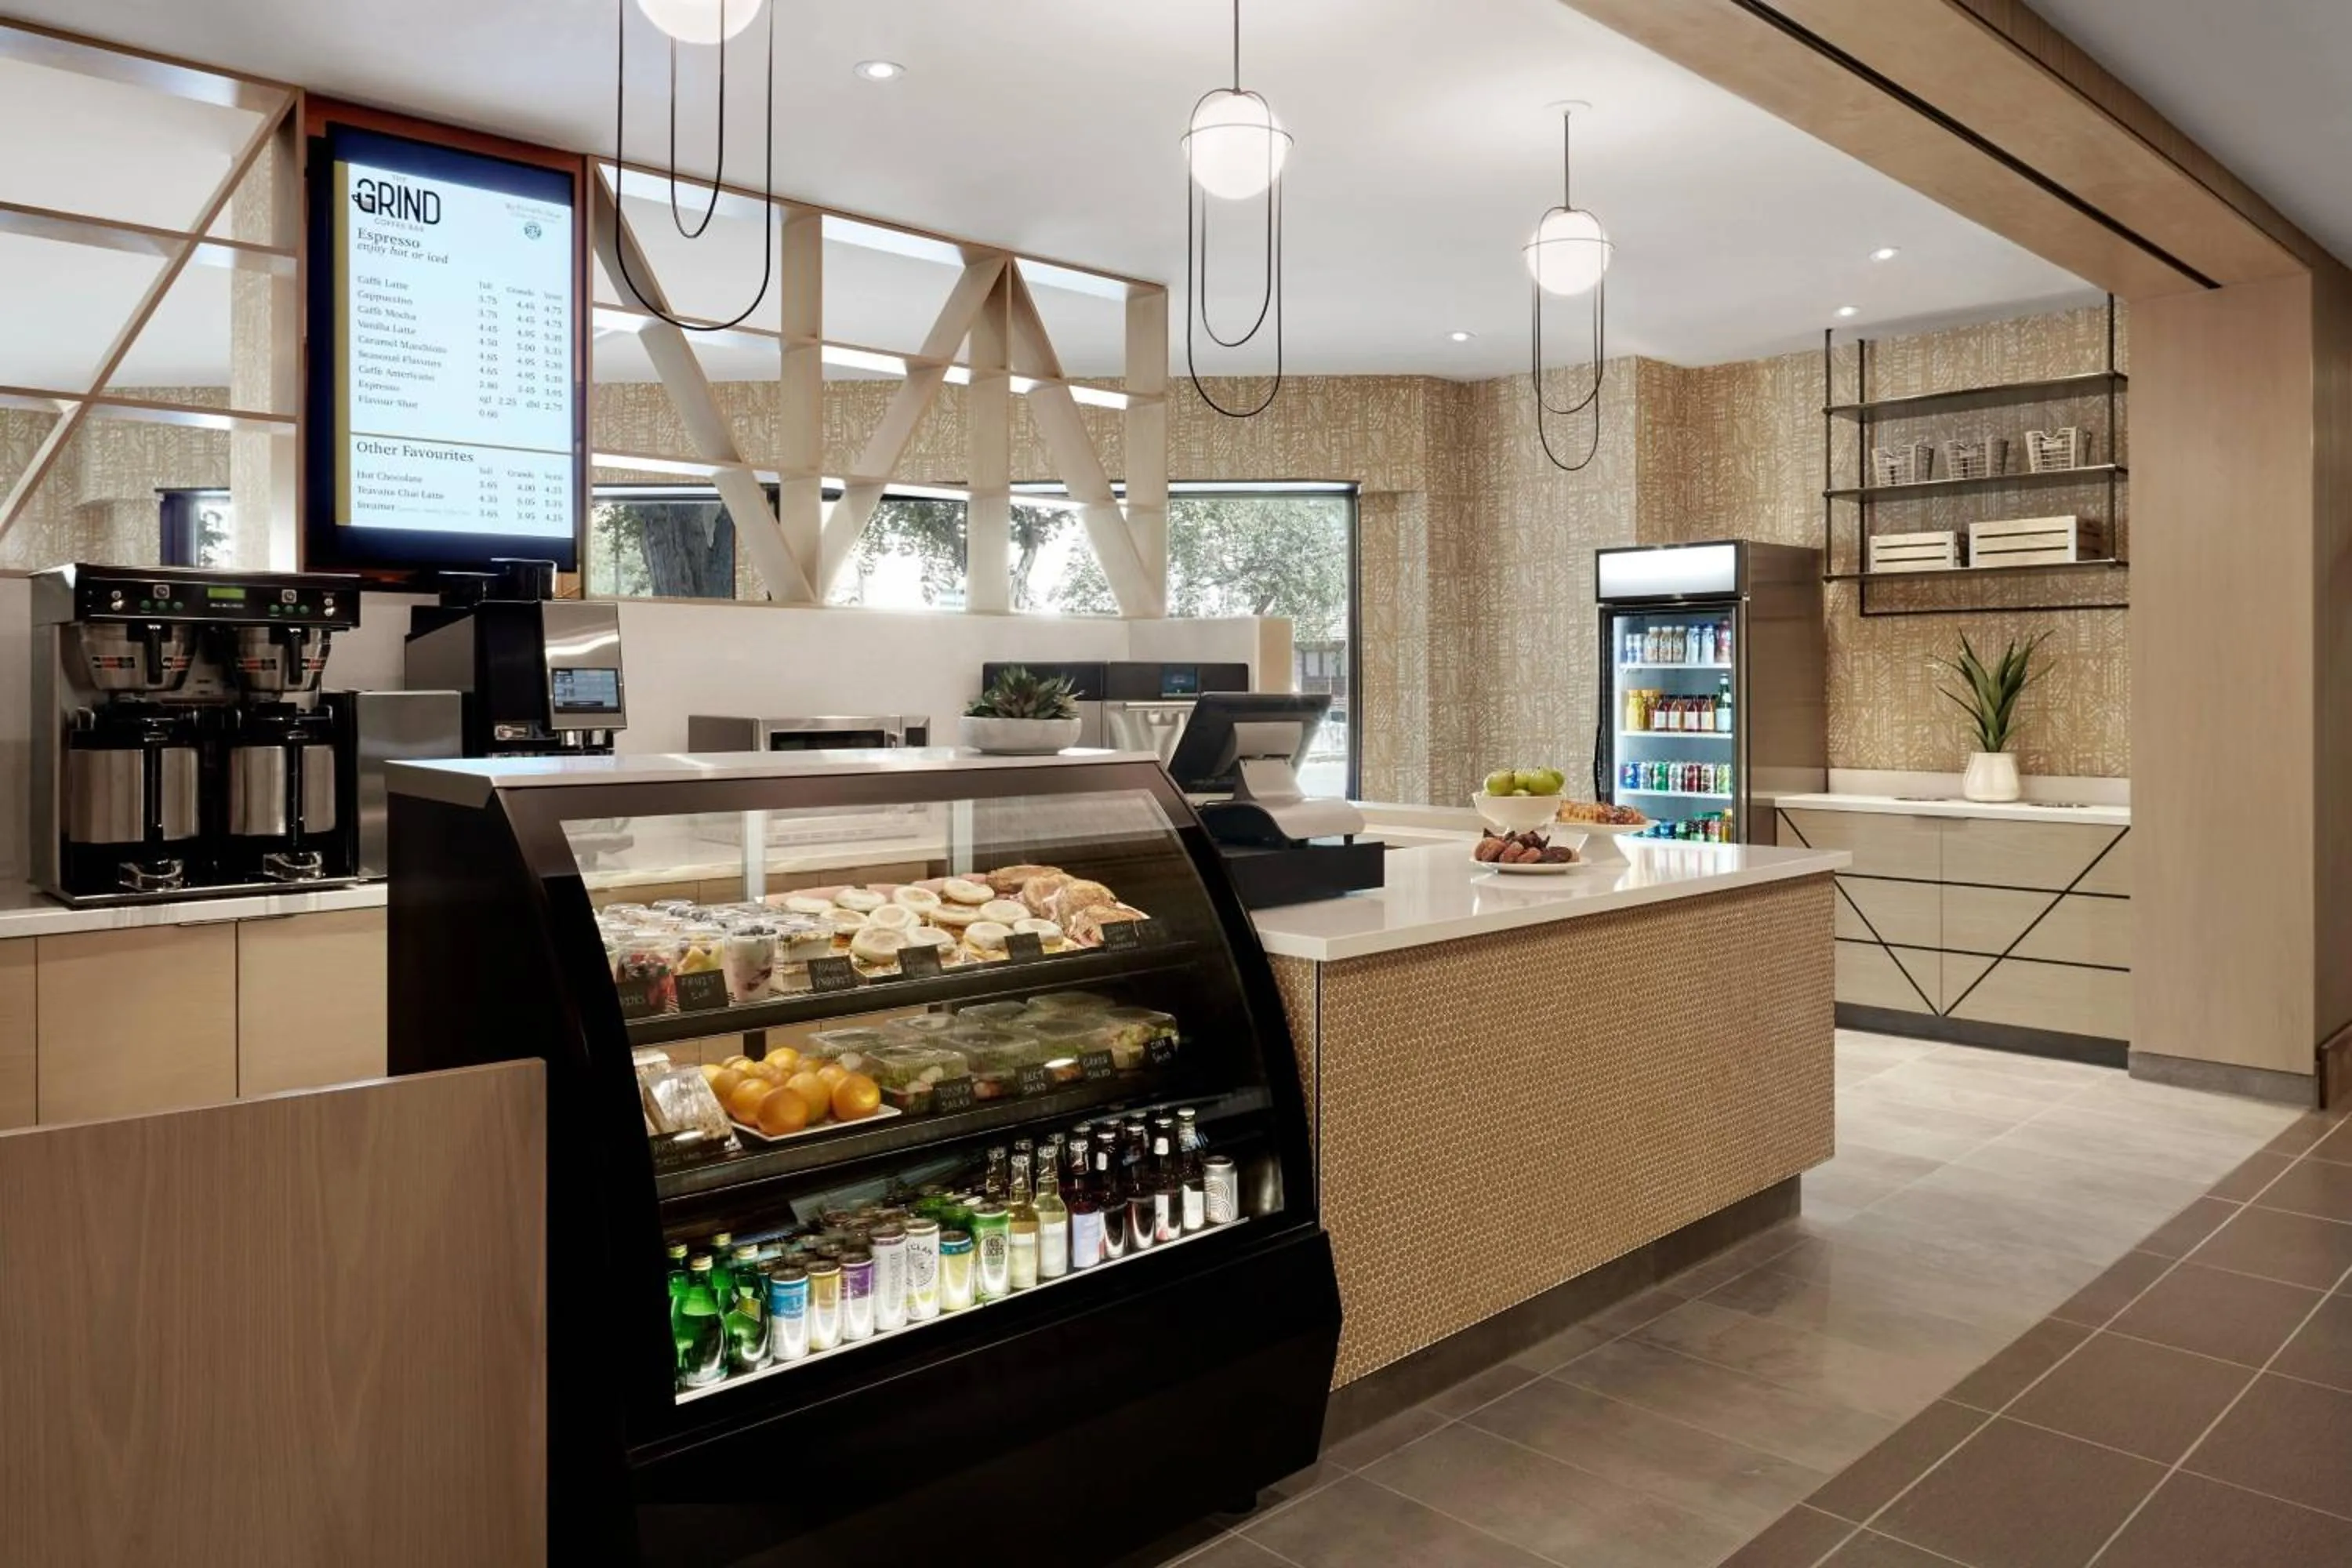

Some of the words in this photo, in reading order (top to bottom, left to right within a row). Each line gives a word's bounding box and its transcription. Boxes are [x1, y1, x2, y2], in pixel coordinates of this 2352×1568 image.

[357, 178, 441, 225] GRIND
[358, 227, 420, 249] Espresso
[358, 242, 386, 255] enjoy
[390, 246, 408, 257] hot
[427, 252, 448, 264] iced
[385, 278, 409, 290] Latte
[358, 290, 413, 305] Cappuccino
[385, 309, 417, 321] Mocha
[358, 319, 390, 332] Vanilla
[393, 324, 417, 335] Latte
[358, 335, 398, 348] Caramel
[358, 350, 400, 362] Seasonal
[387, 368, 435, 381] Americano
[358, 379, 401, 391] Espresso
[358, 395, 394, 406] Flavour
[357, 441, 398, 456] Other
[403, 445, 474, 462] Favourites
[357, 470, 374, 480] Hot
[377, 471, 423, 484] Chocolate
[358, 485, 397, 496] Teavana
[397, 488, 419, 499] Chai
[421, 490, 445, 500] Latte
[357, 500, 395, 512] Steamer
